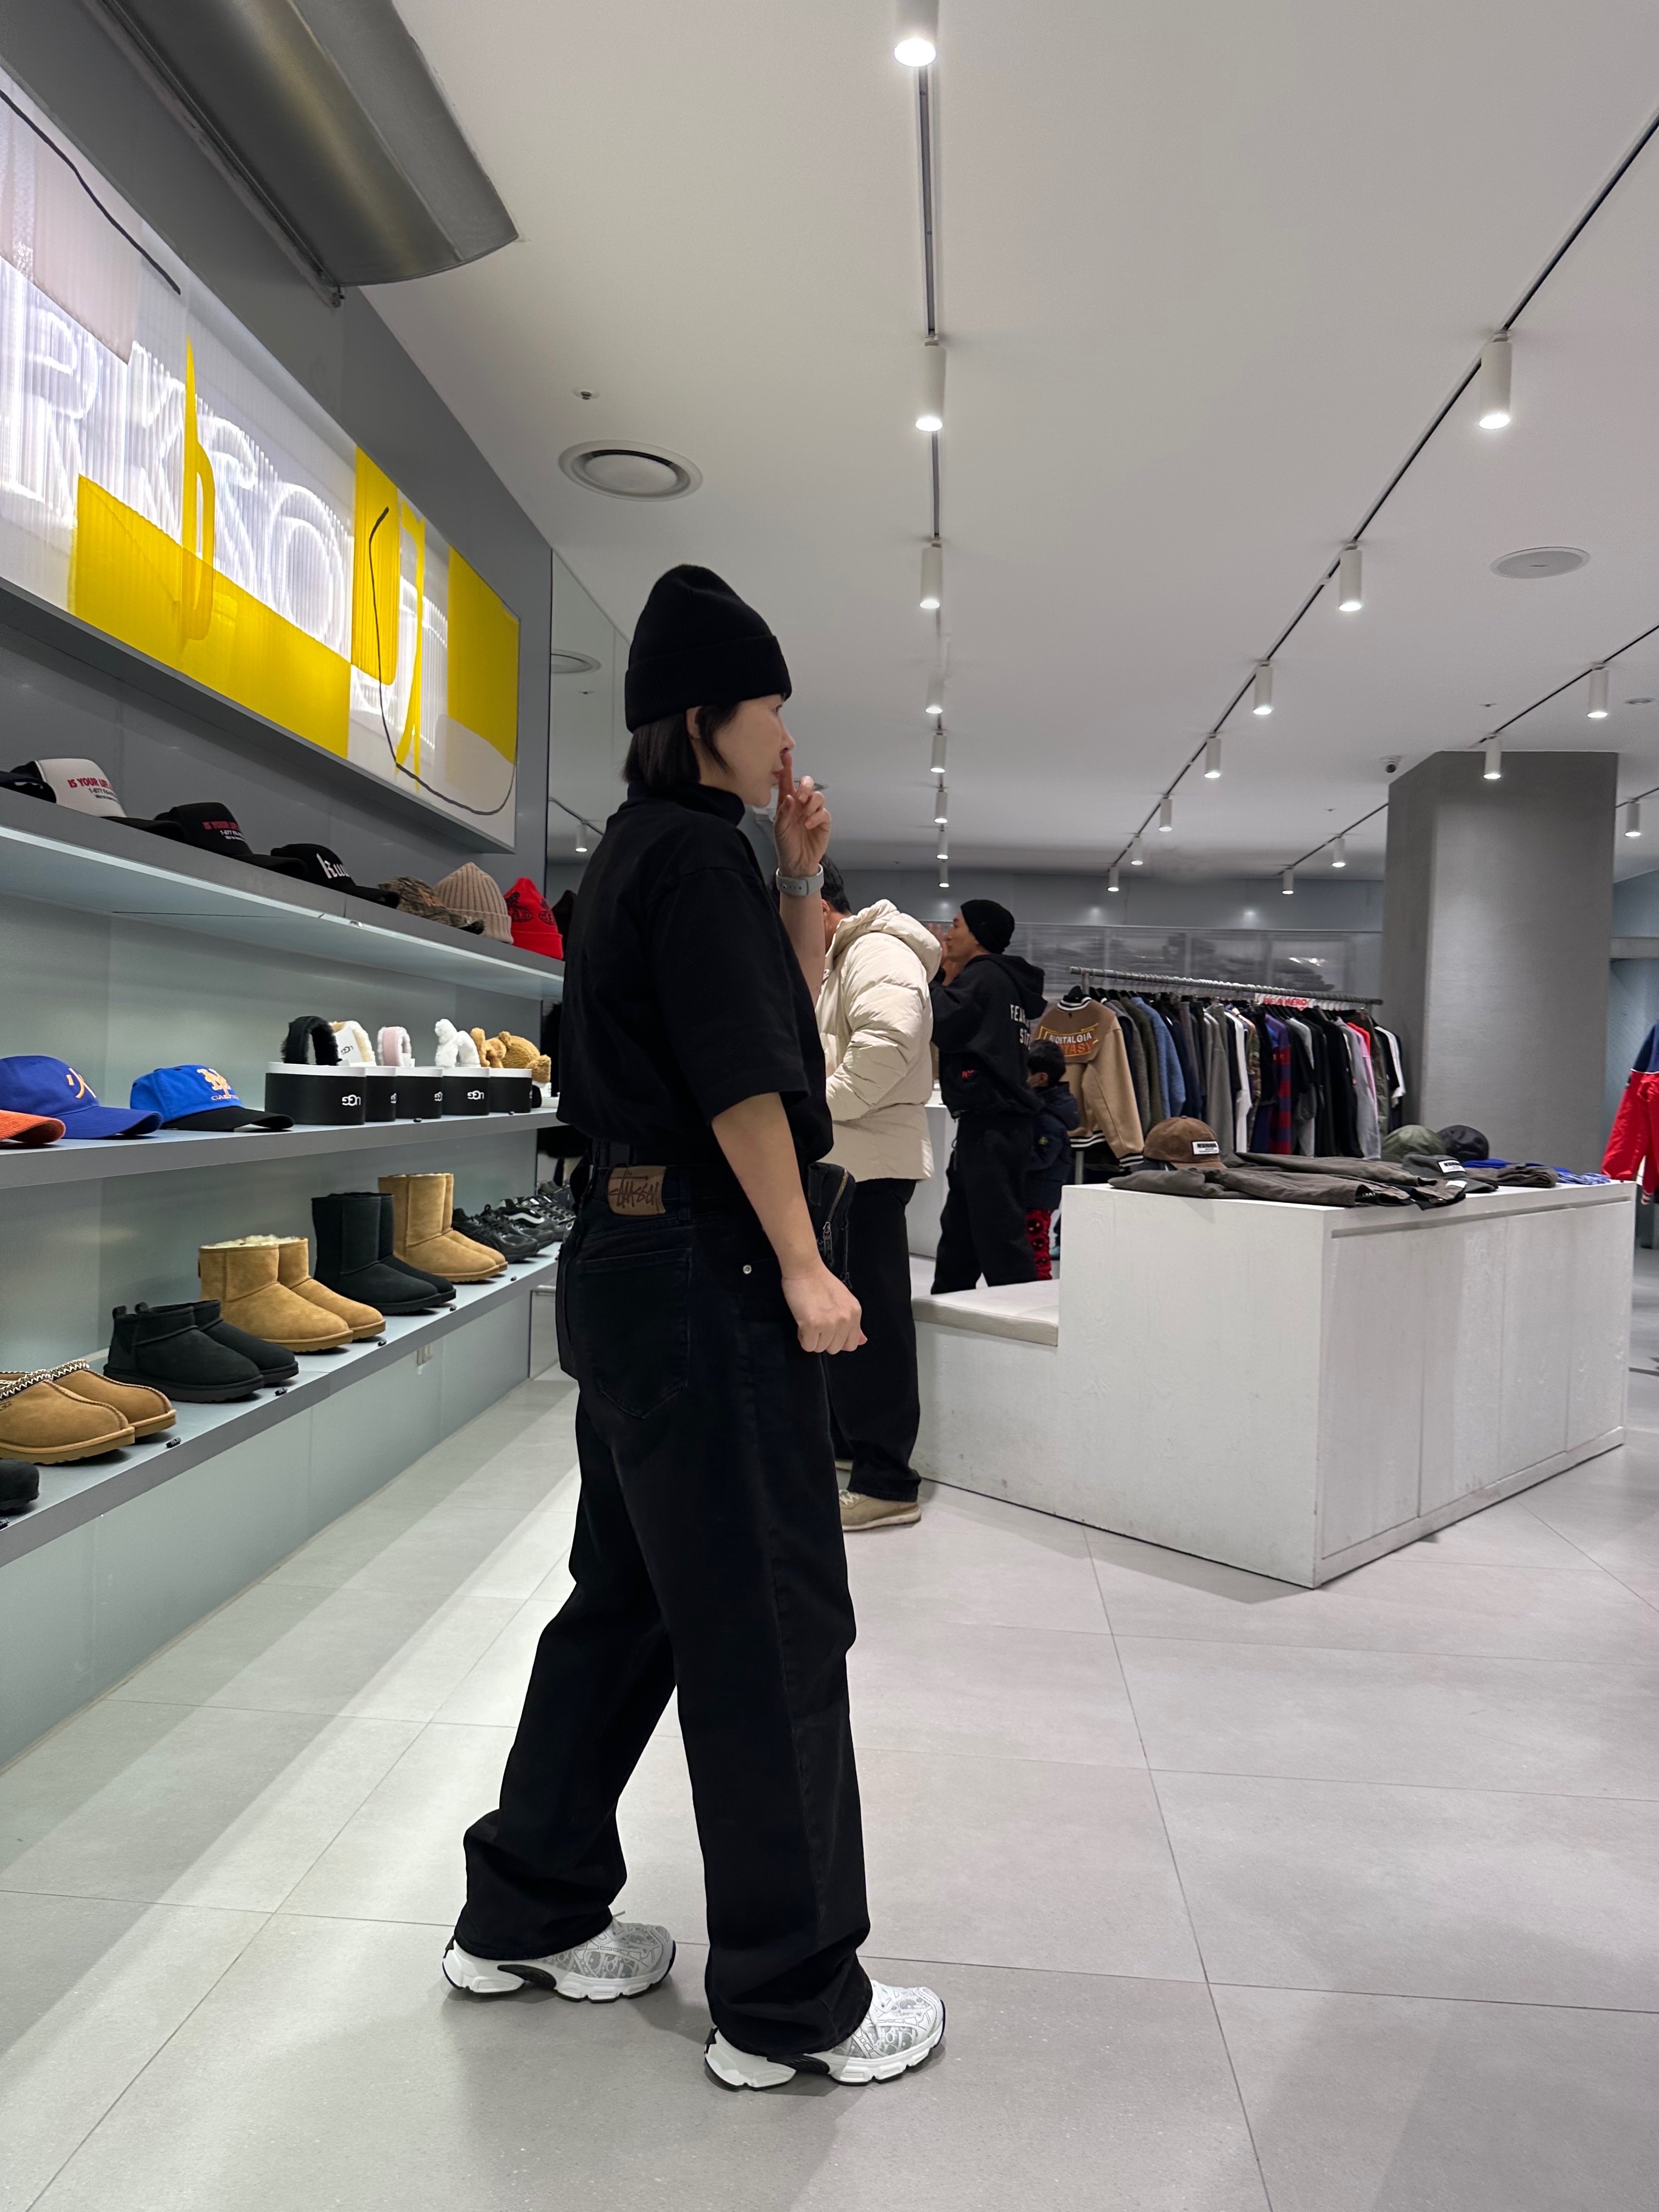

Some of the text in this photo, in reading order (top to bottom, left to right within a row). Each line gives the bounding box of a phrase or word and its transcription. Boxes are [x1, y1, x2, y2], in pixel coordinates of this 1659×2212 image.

[67, 779, 77, 788] IS
[77, 777, 99, 787] YOUR
[1048, 1032, 1092, 1044] NOSTALGIA
[342, 1094, 361, 1106] UGG
[467, 1090, 484, 1100] UGG
